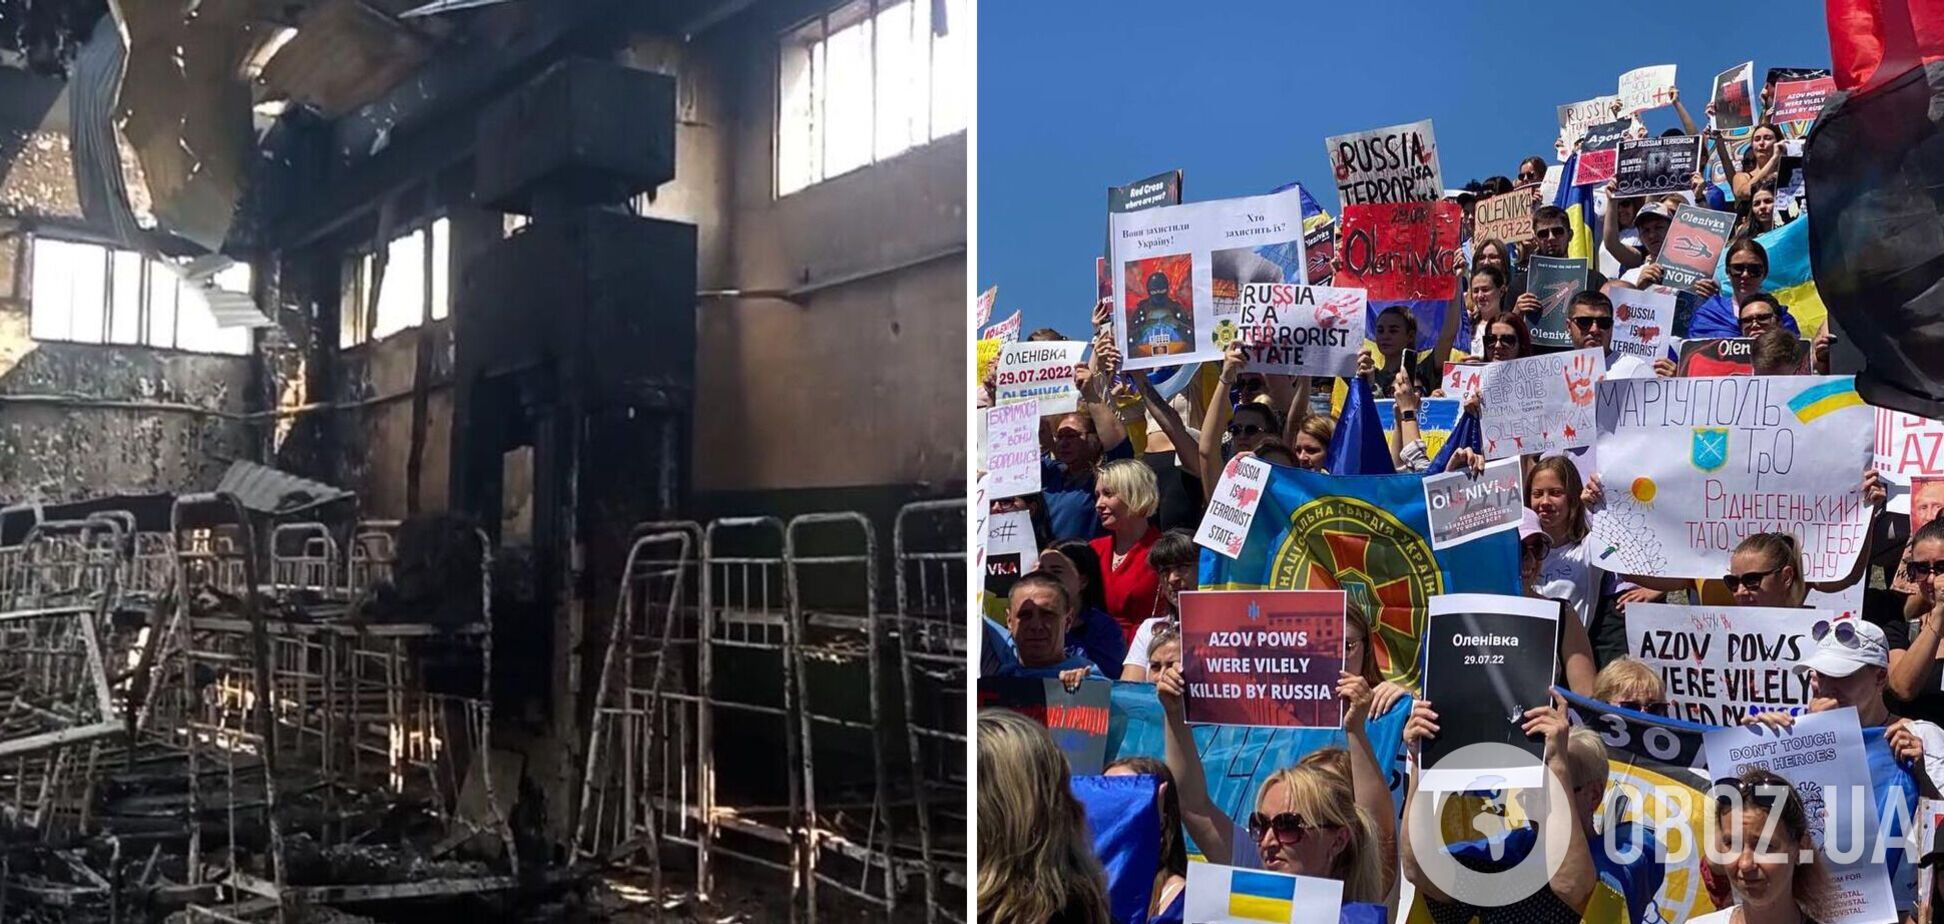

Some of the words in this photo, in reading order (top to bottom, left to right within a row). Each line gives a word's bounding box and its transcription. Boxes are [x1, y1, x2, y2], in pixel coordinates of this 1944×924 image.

[1624, 142, 1637, 150] STOP
[1638, 139, 1662, 148] RUSSIAN
[1663, 137, 1695, 146] TERRORISM
[1339, 131, 1424, 176] RUSSIA
[1130, 185, 1144, 198] Red
[1144, 182, 1164, 195] Cross
[1125, 199, 1142, 210] where
[1142, 197, 1152, 205] are
[1152, 191, 1166, 204] you?
[1477, 193, 1532, 226] OLENIVKA
[1247, 213, 1265, 223] Хто
[1681, 212, 1725, 229] Olenivka
[1122, 230, 1144, 239] Вони
[1147, 223, 1190, 235] захистили
[1225, 226, 1272, 239] захистить
[1137, 235, 1174, 249] Україну!
[1344, 223, 1455, 278] Olenivka
[1665, 269, 1696, 285] NOW
[1244, 285, 1315, 307] RUSSIA
[1241, 305, 1256, 324] IS
[1262, 305, 1279, 324] A
[1627, 305, 1656, 321] RUSSIA
[1239, 325, 1350, 348] TERRORIST
[1530, 328, 1571, 340] Olenivk
[1630, 325, 1637, 336] IS
[1240, 344, 1304, 366] STATE
[1613, 340, 1658, 357] TERRORIST
[1718, 339, 1751, 356] Olen
[1005, 348, 1067, 366] ОЛЕНІВКА
[998, 365, 1073, 386] 29.07.2022
[1596, 378, 1782, 428] МАРІУПОЛЬ
[1485, 410, 1592, 441] OLENIVKA
[1234, 460, 1261, 482] RUSSIA
[1229, 484, 1240, 498] IS
[1209, 500, 1252, 528] TERRORIST
[1208, 524, 1234, 546] STATE
[1685, 521, 1732, 553] ТАТО,
[1812, 522, 1864, 554] ТЕБЕ
[1337, 502, 1396, 536] ГВАРДІЯ
[1400, 533, 1436, 595] УКРАЇН
[987, 561, 1019, 576] VKA
[1801, 553, 1839, 578] ОНУ
[1209, 632, 1253, 647] AZOV
[1257, 632, 1308, 647] POWS
[1452, 633, 1519, 647] Оленівка
[1640, 630, 1712, 660] AZOV
[1728, 633, 1806, 662] POWS
[1206, 658, 1250, 673] WERE
[1254, 658, 1310, 673] VILELY
[1464, 655, 1505, 665] 29.07.22
[1189, 683, 1241, 698] KILLED
[1246, 684, 1267, 699] BY
[1271, 684, 1332, 700] RUSSIA
[1723, 669, 1814, 705] VILELY
[1729, 741, 1777, 762] DON'T
[1781, 731, 1837, 753] TOUCH
[1773, 747, 1837, 771] HEROES
[1845, 872, 1862, 881] FOR
